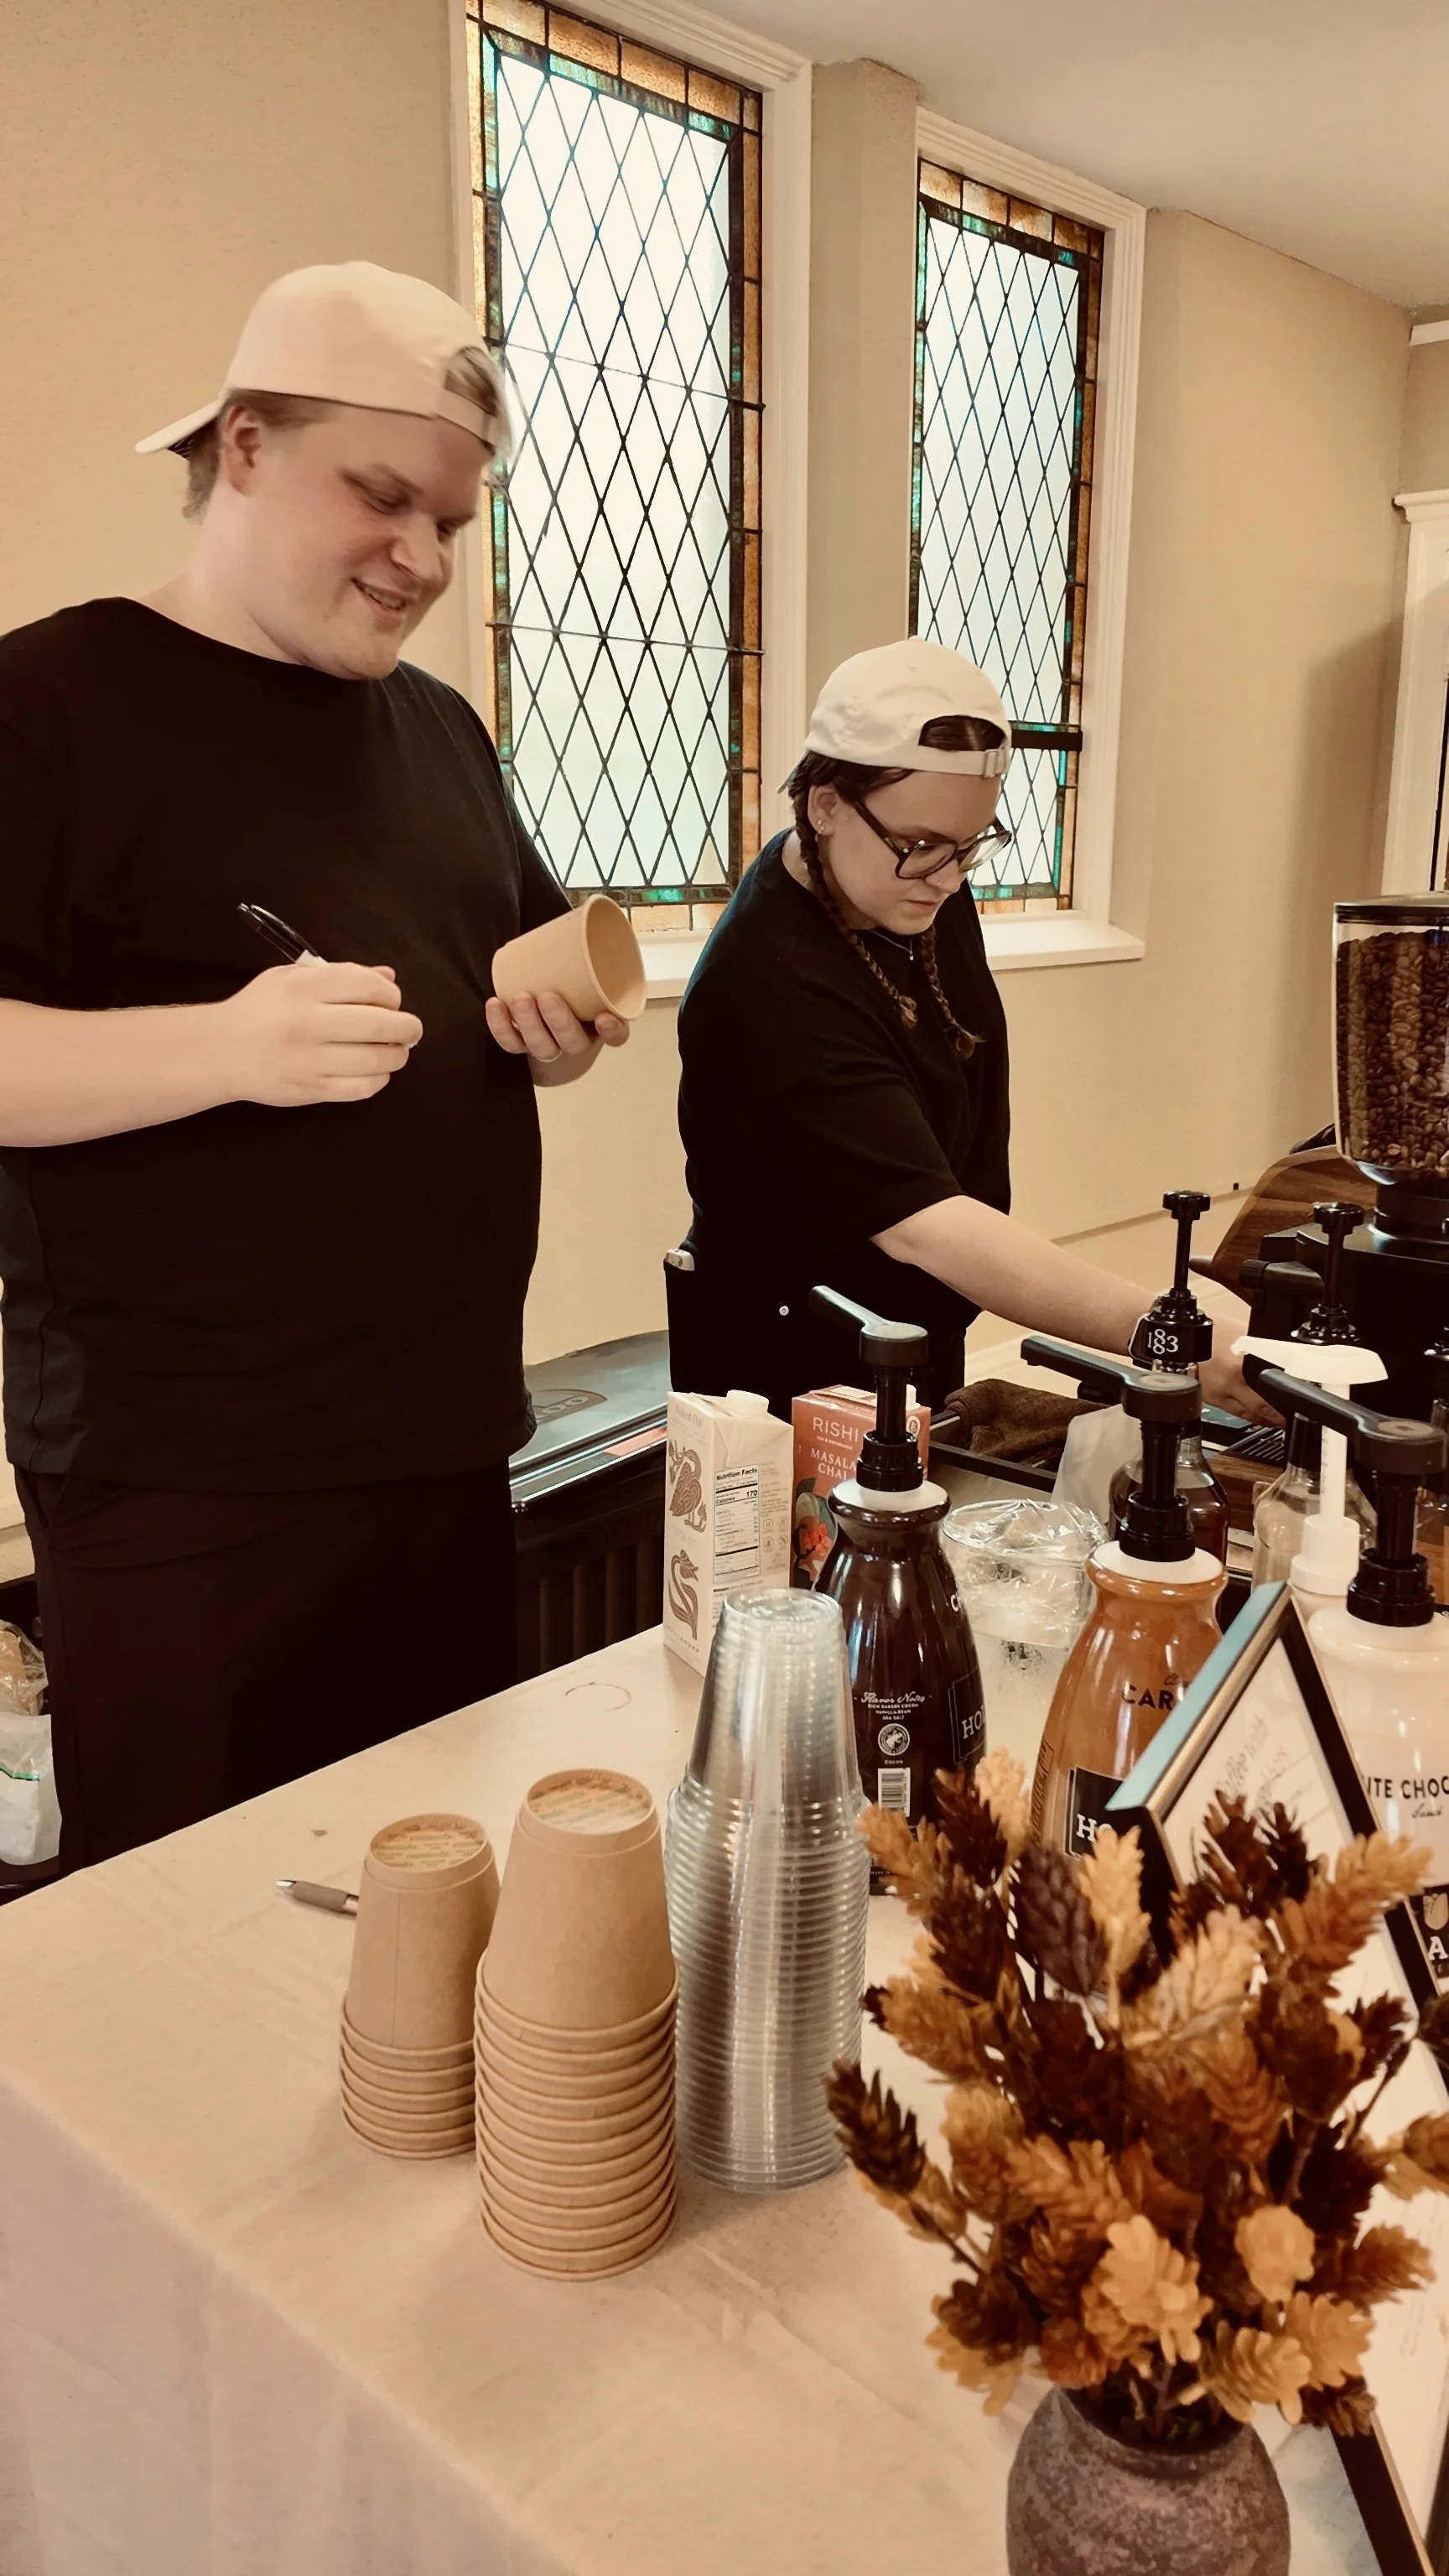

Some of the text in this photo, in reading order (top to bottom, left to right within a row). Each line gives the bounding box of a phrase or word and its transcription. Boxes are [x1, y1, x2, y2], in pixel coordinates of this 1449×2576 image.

[813, 1415, 860, 1443] RISHI
[741, 1467, 758, 1476] Facts
[818, 1463, 847, 1481] CHAI
[746, 1489, 758, 1498] 170
